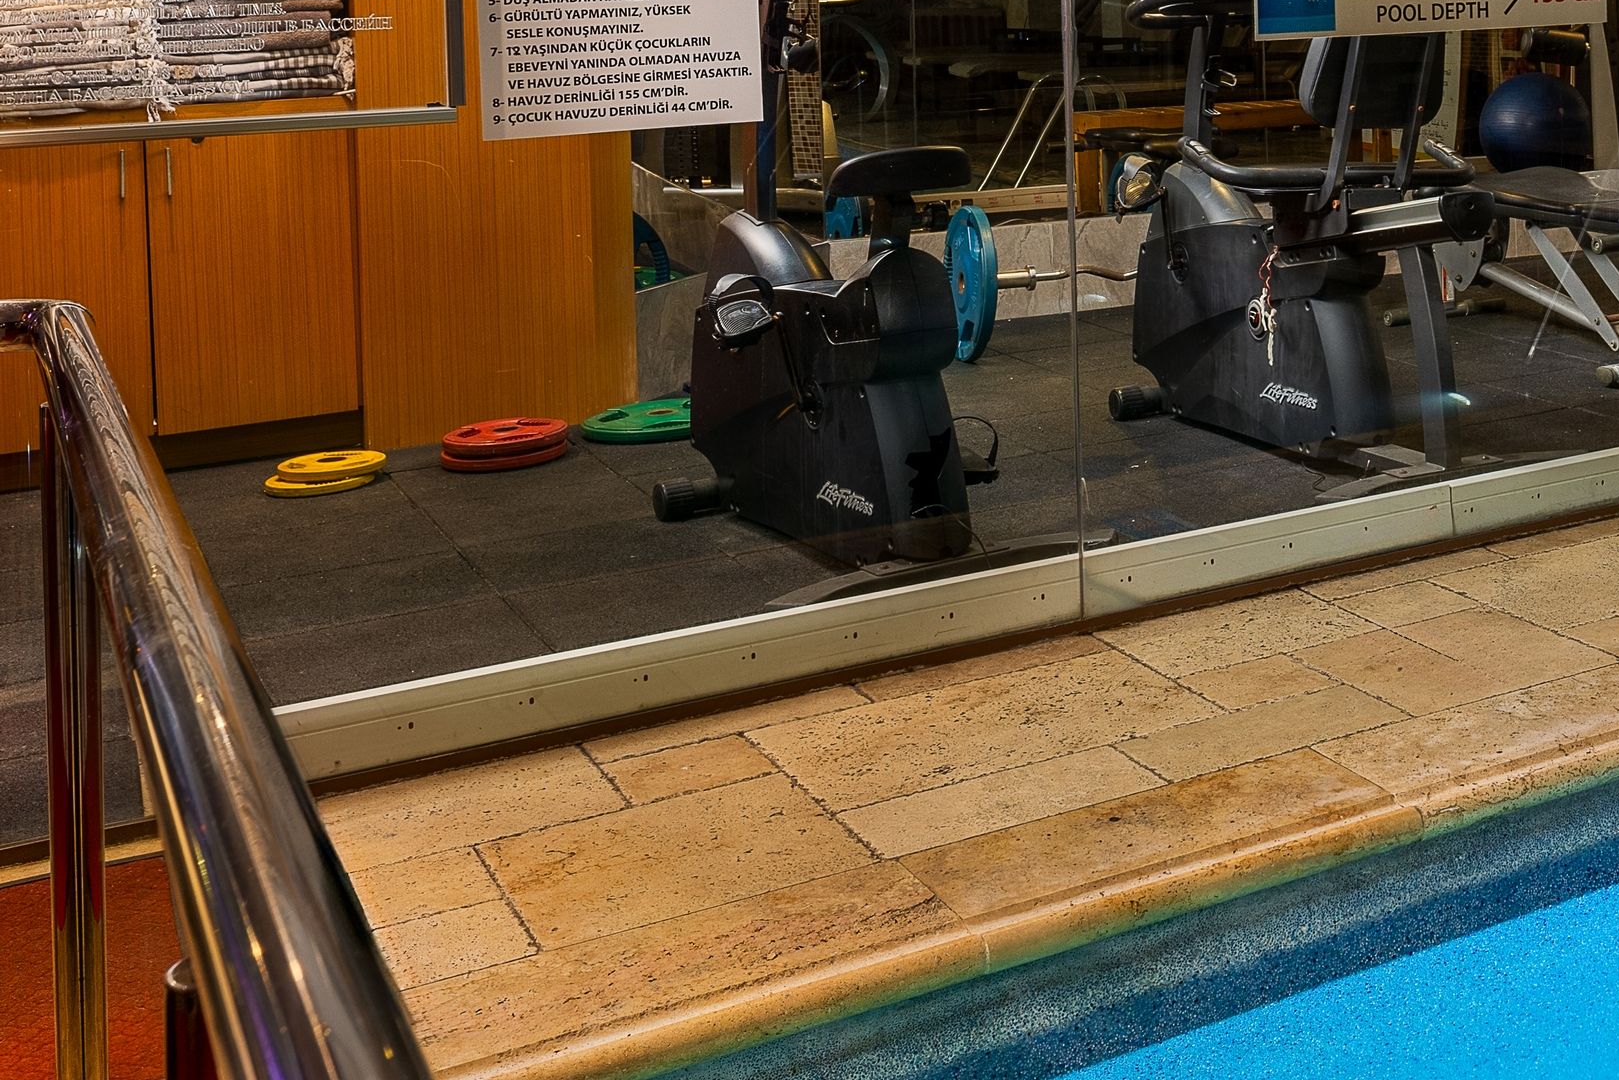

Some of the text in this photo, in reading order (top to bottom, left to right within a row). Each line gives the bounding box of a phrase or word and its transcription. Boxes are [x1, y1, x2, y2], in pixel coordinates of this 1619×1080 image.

[488, 4, 691, 23] 6- GÜRÜLTÜ YAPMAYINIZ, YÜKSEK
[1376, 0, 1489, 23] POOL DEPTH
[506, 23, 644, 39] SESLE KONUŞMAYINIZ.
[490, 47, 503, 57] 7-
[522, 42, 587, 57] YAŞINDAN
[589, 38, 633, 54] KÜÇÜK
[634, 36, 711, 52] ÇOCUKLARIN
[507, 51, 741, 73] EBEVEYNİ YANINDA OLMADAN HAVUZA
[507, 66, 753, 90] VE HAVUZ BÖLGESİNE GİRMESİ YASAKTIR.
[492, 97, 505, 108] 8-
[507, 94, 552, 107] HAVUZ
[554, 88, 615, 104] DERİNLİĞİ
[618, 89, 640, 100] 155
[492, 114, 506, 125] 9-
[508, 111, 553, 127] ÇOCUK
[554, 107, 607, 121] HAVUZU
[609, 101, 669, 117] DERİNLİĞİ
[671, 102, 686, 113] 44
